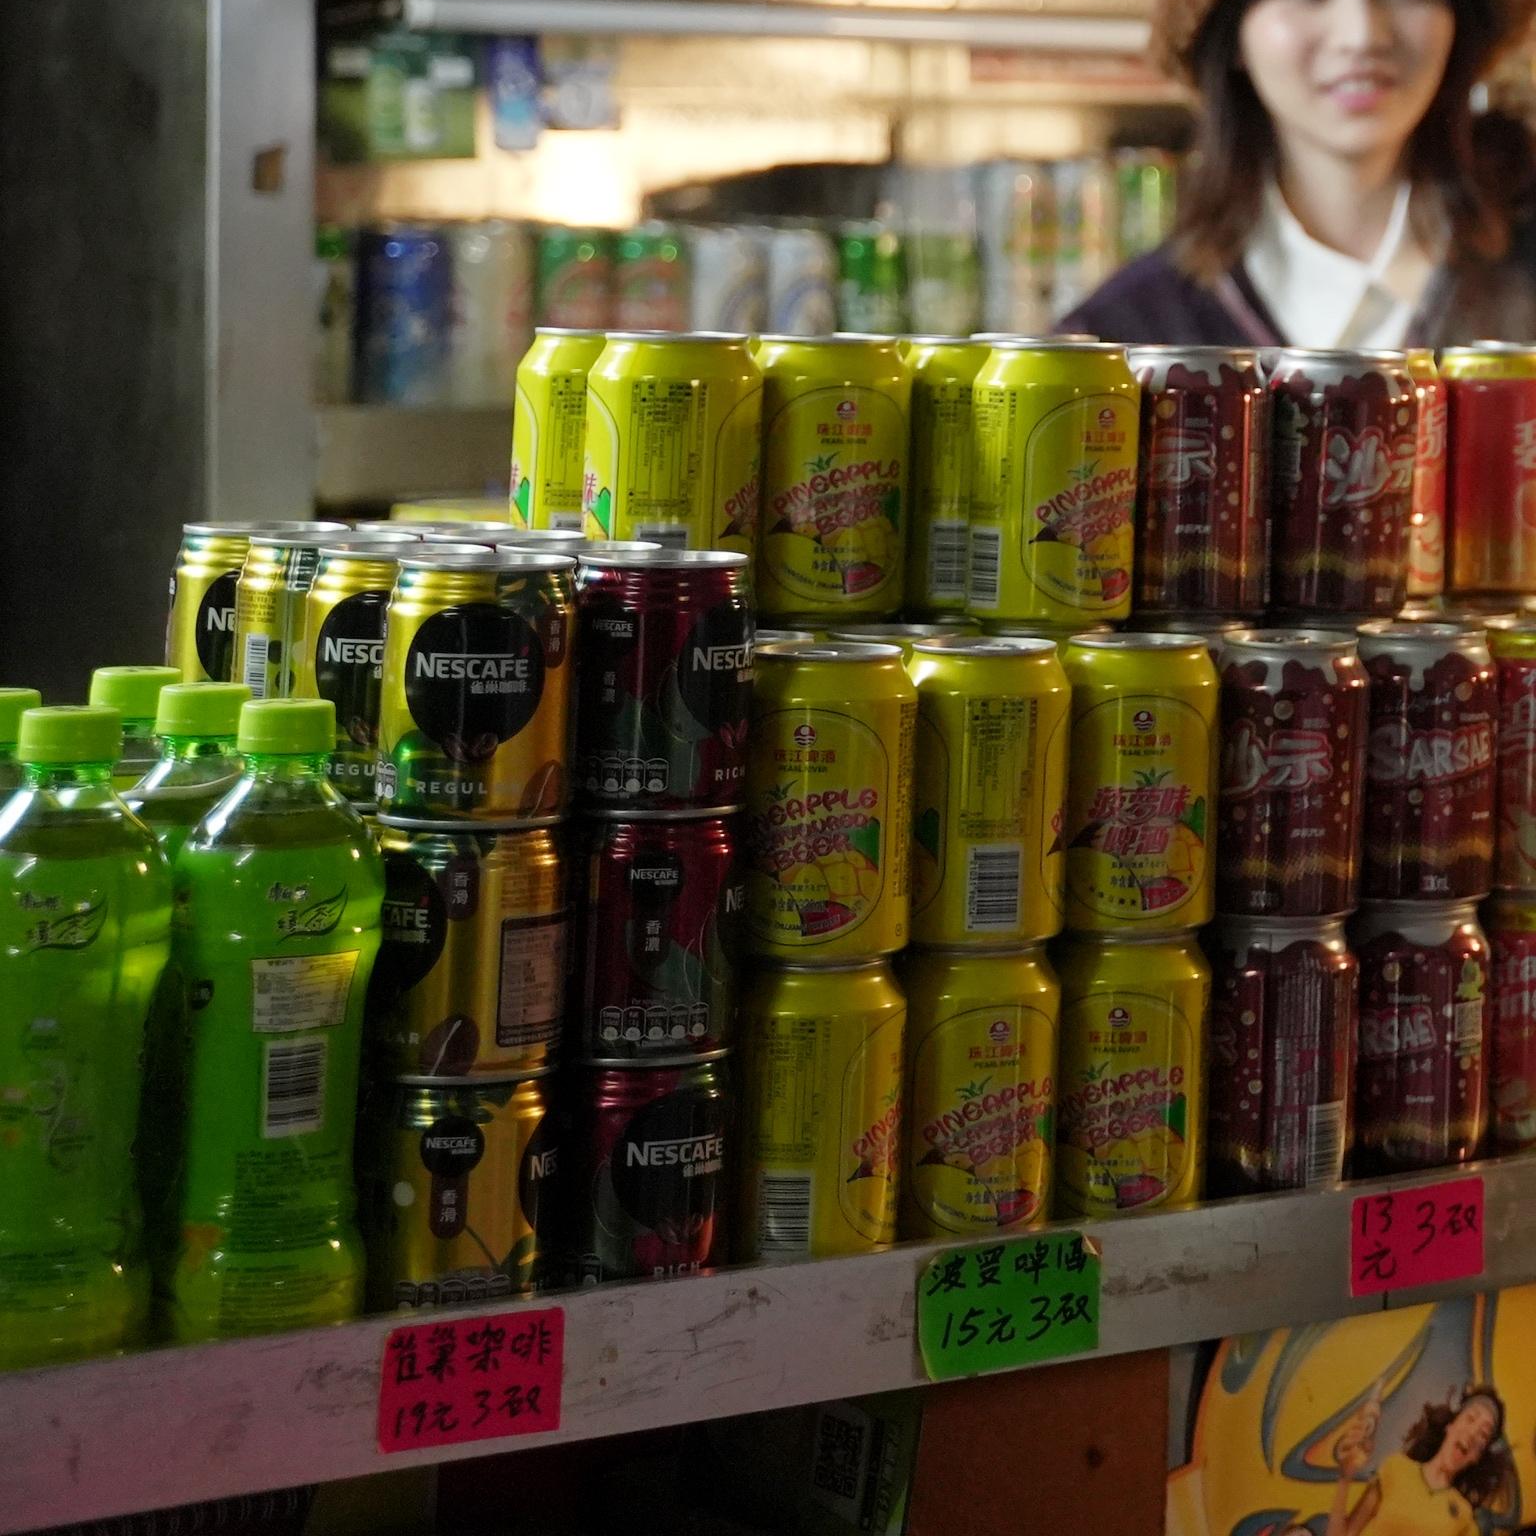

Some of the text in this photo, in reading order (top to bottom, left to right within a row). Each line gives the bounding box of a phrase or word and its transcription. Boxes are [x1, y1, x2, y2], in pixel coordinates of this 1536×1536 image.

[1034, 467, 1138, 526] PINEAPPL
[324, 634, 384, 666] NESC
[320, 762, 378, 777] REGU
[414, 781, 488, 797] REGUL
[921, 1075, 1053, 1147] PINEAPPLE
[1362, 1196, 1394, 1237] 13
